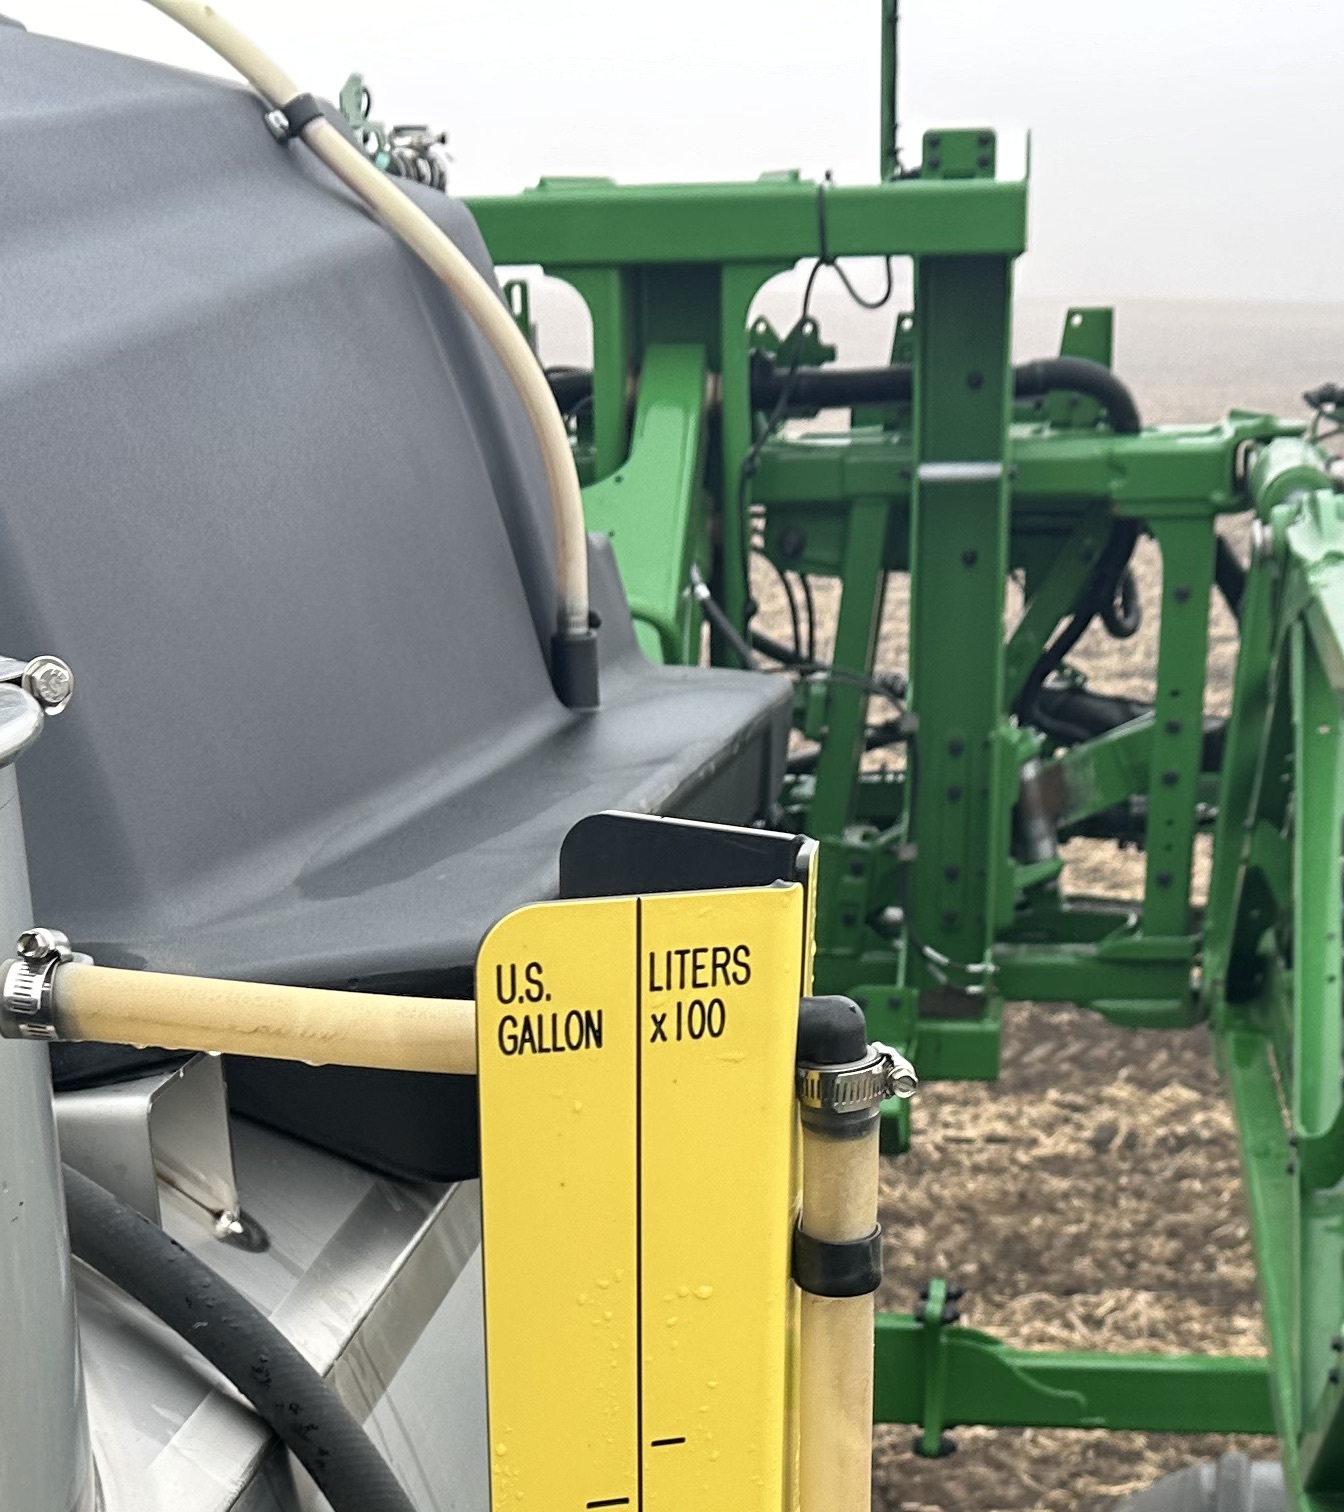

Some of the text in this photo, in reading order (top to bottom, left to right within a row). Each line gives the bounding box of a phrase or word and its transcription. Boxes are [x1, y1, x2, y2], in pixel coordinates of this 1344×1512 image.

[496, 962, 552, 1004] U.S.
[649, 945, 752, 992] LITERS
[498, 1009, 603, 1056] GALLON
[650, 998, 726, 1043] x100
